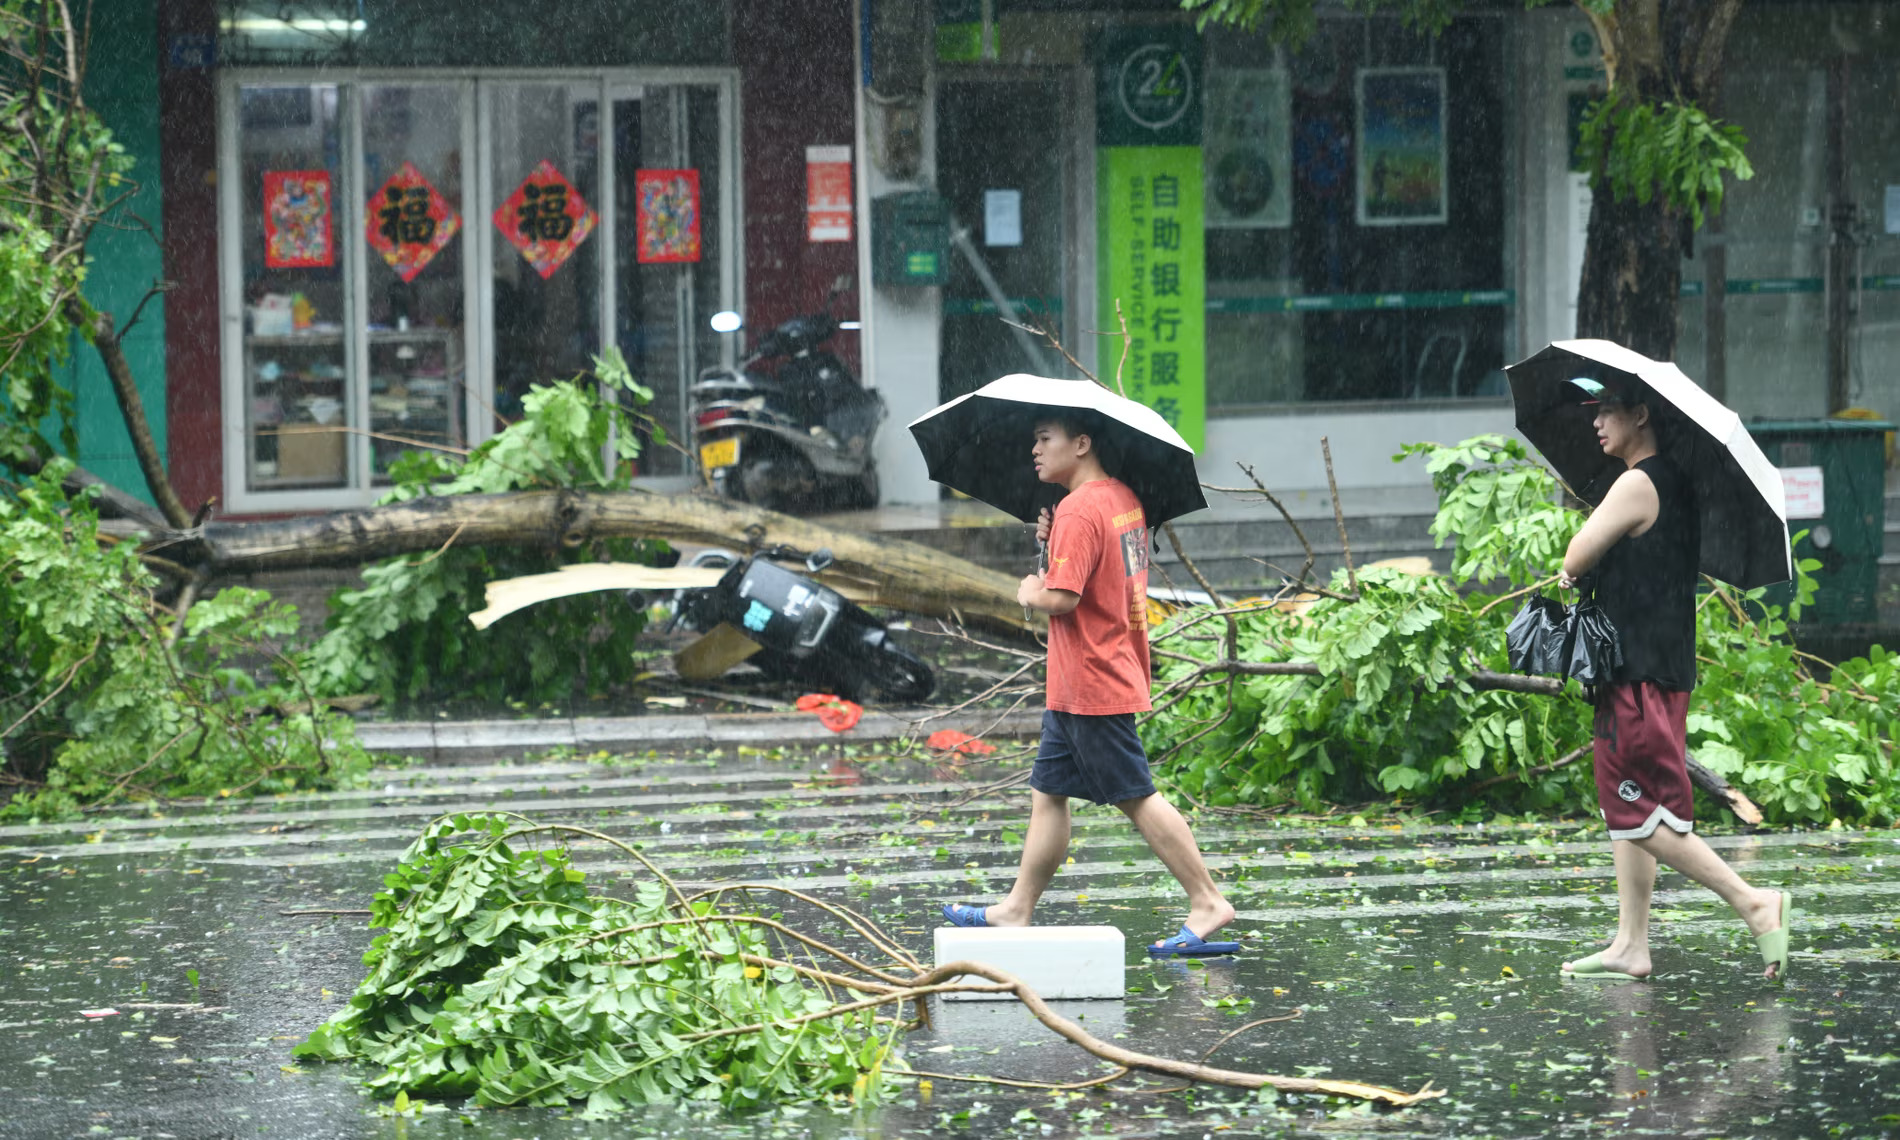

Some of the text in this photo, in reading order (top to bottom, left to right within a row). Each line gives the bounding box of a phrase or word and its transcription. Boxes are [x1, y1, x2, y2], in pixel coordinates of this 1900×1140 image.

[1138, 53, 1183, 106] 24
[378, 185, 436, 244] 福
[518, 183, 574, 241] 福
[1130, 175, 1146, 402] SELF-SERVICE BANK
[1150, 172, 1182, 431] 自助银行服务
